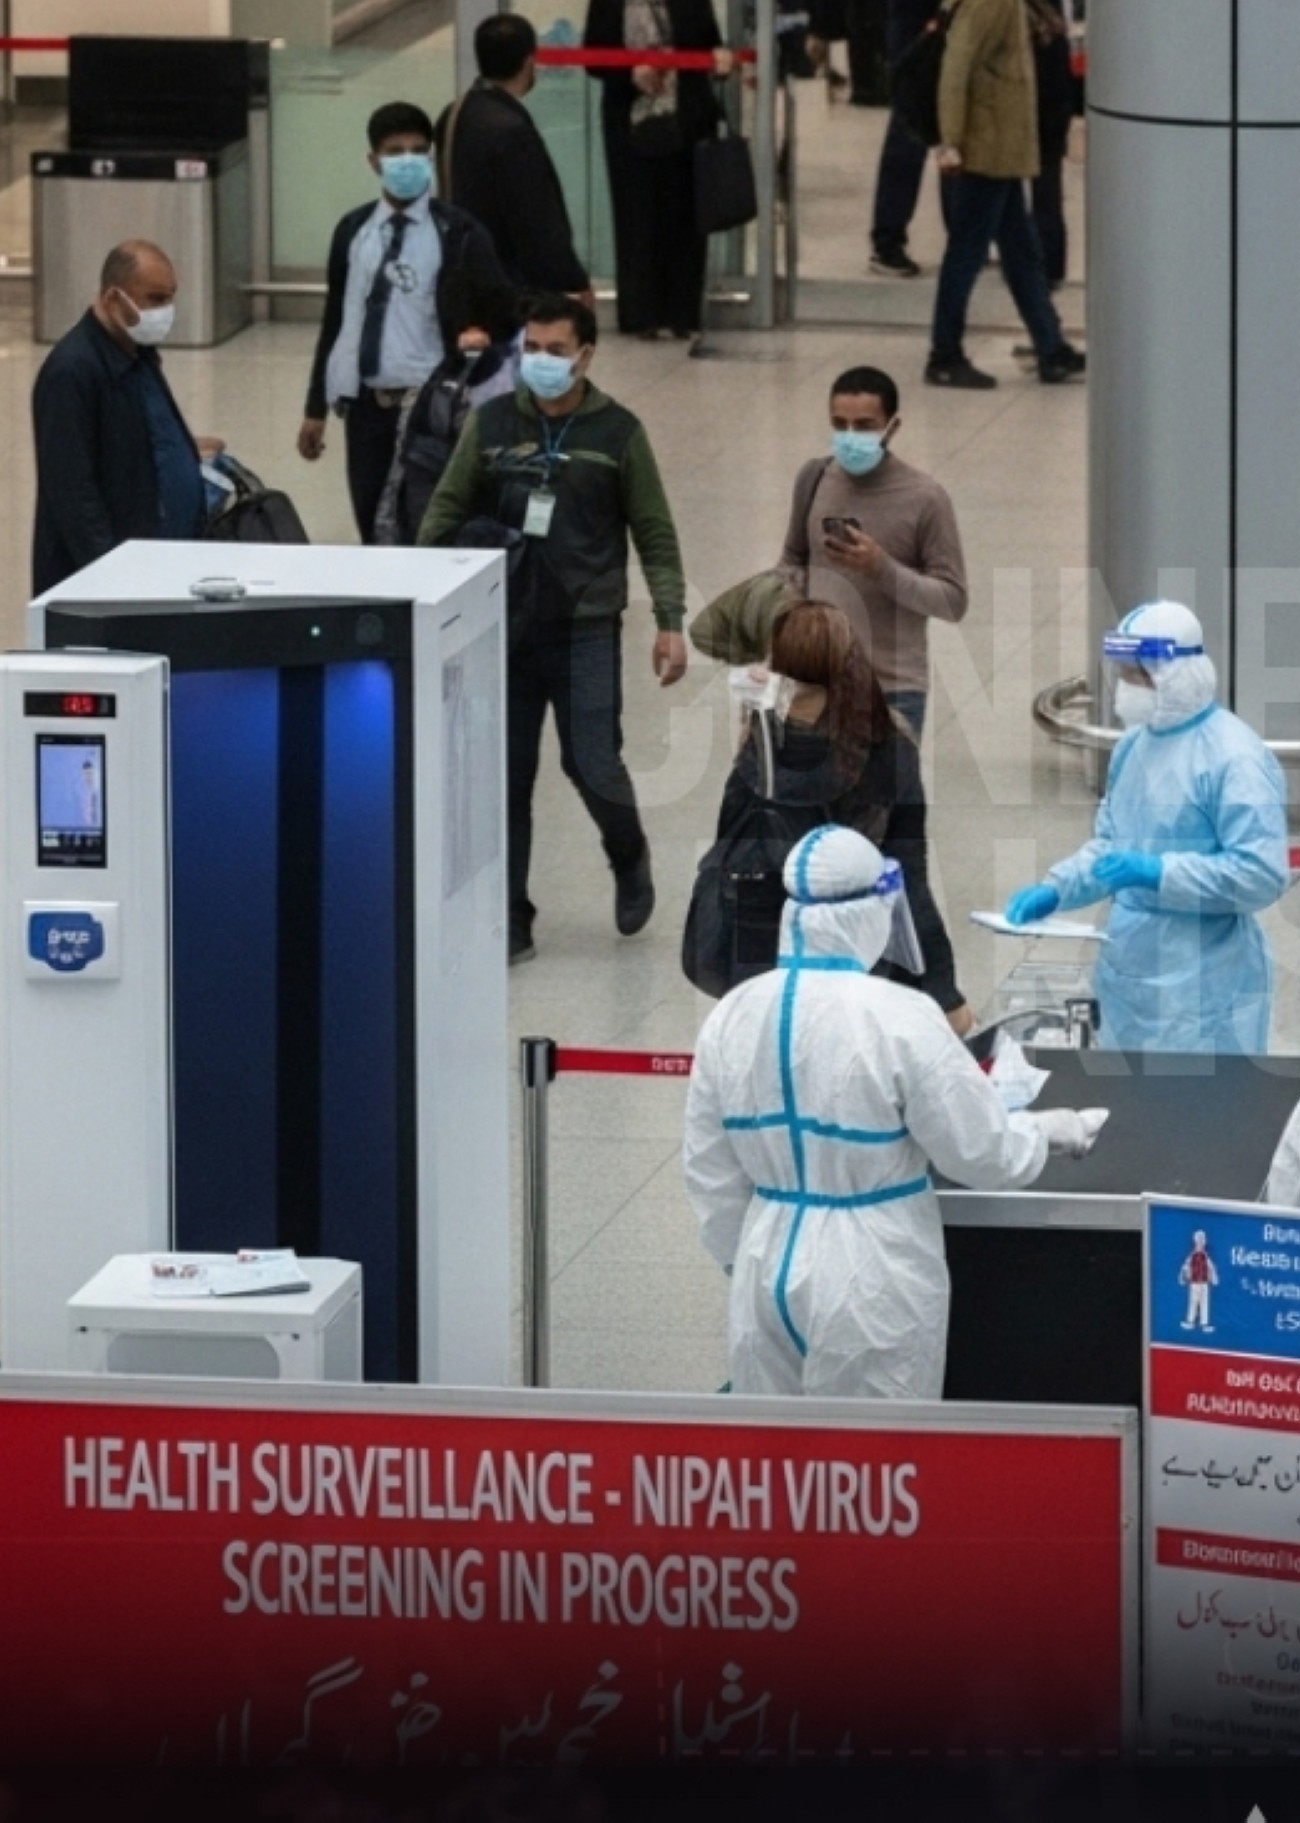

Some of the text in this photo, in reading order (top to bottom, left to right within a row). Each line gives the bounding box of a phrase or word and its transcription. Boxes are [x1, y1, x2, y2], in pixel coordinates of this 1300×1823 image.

[64, 1437, 240, 1514] HEALTH
[251, 1442, 594, 1525] SURVEILLANCE
[632, 1456, 772, 1530] NIPAH
[784, 1460, 919, 1536] VIRUS
[222, 1540, 797, 1631] SCREENING IN PROGRESS
